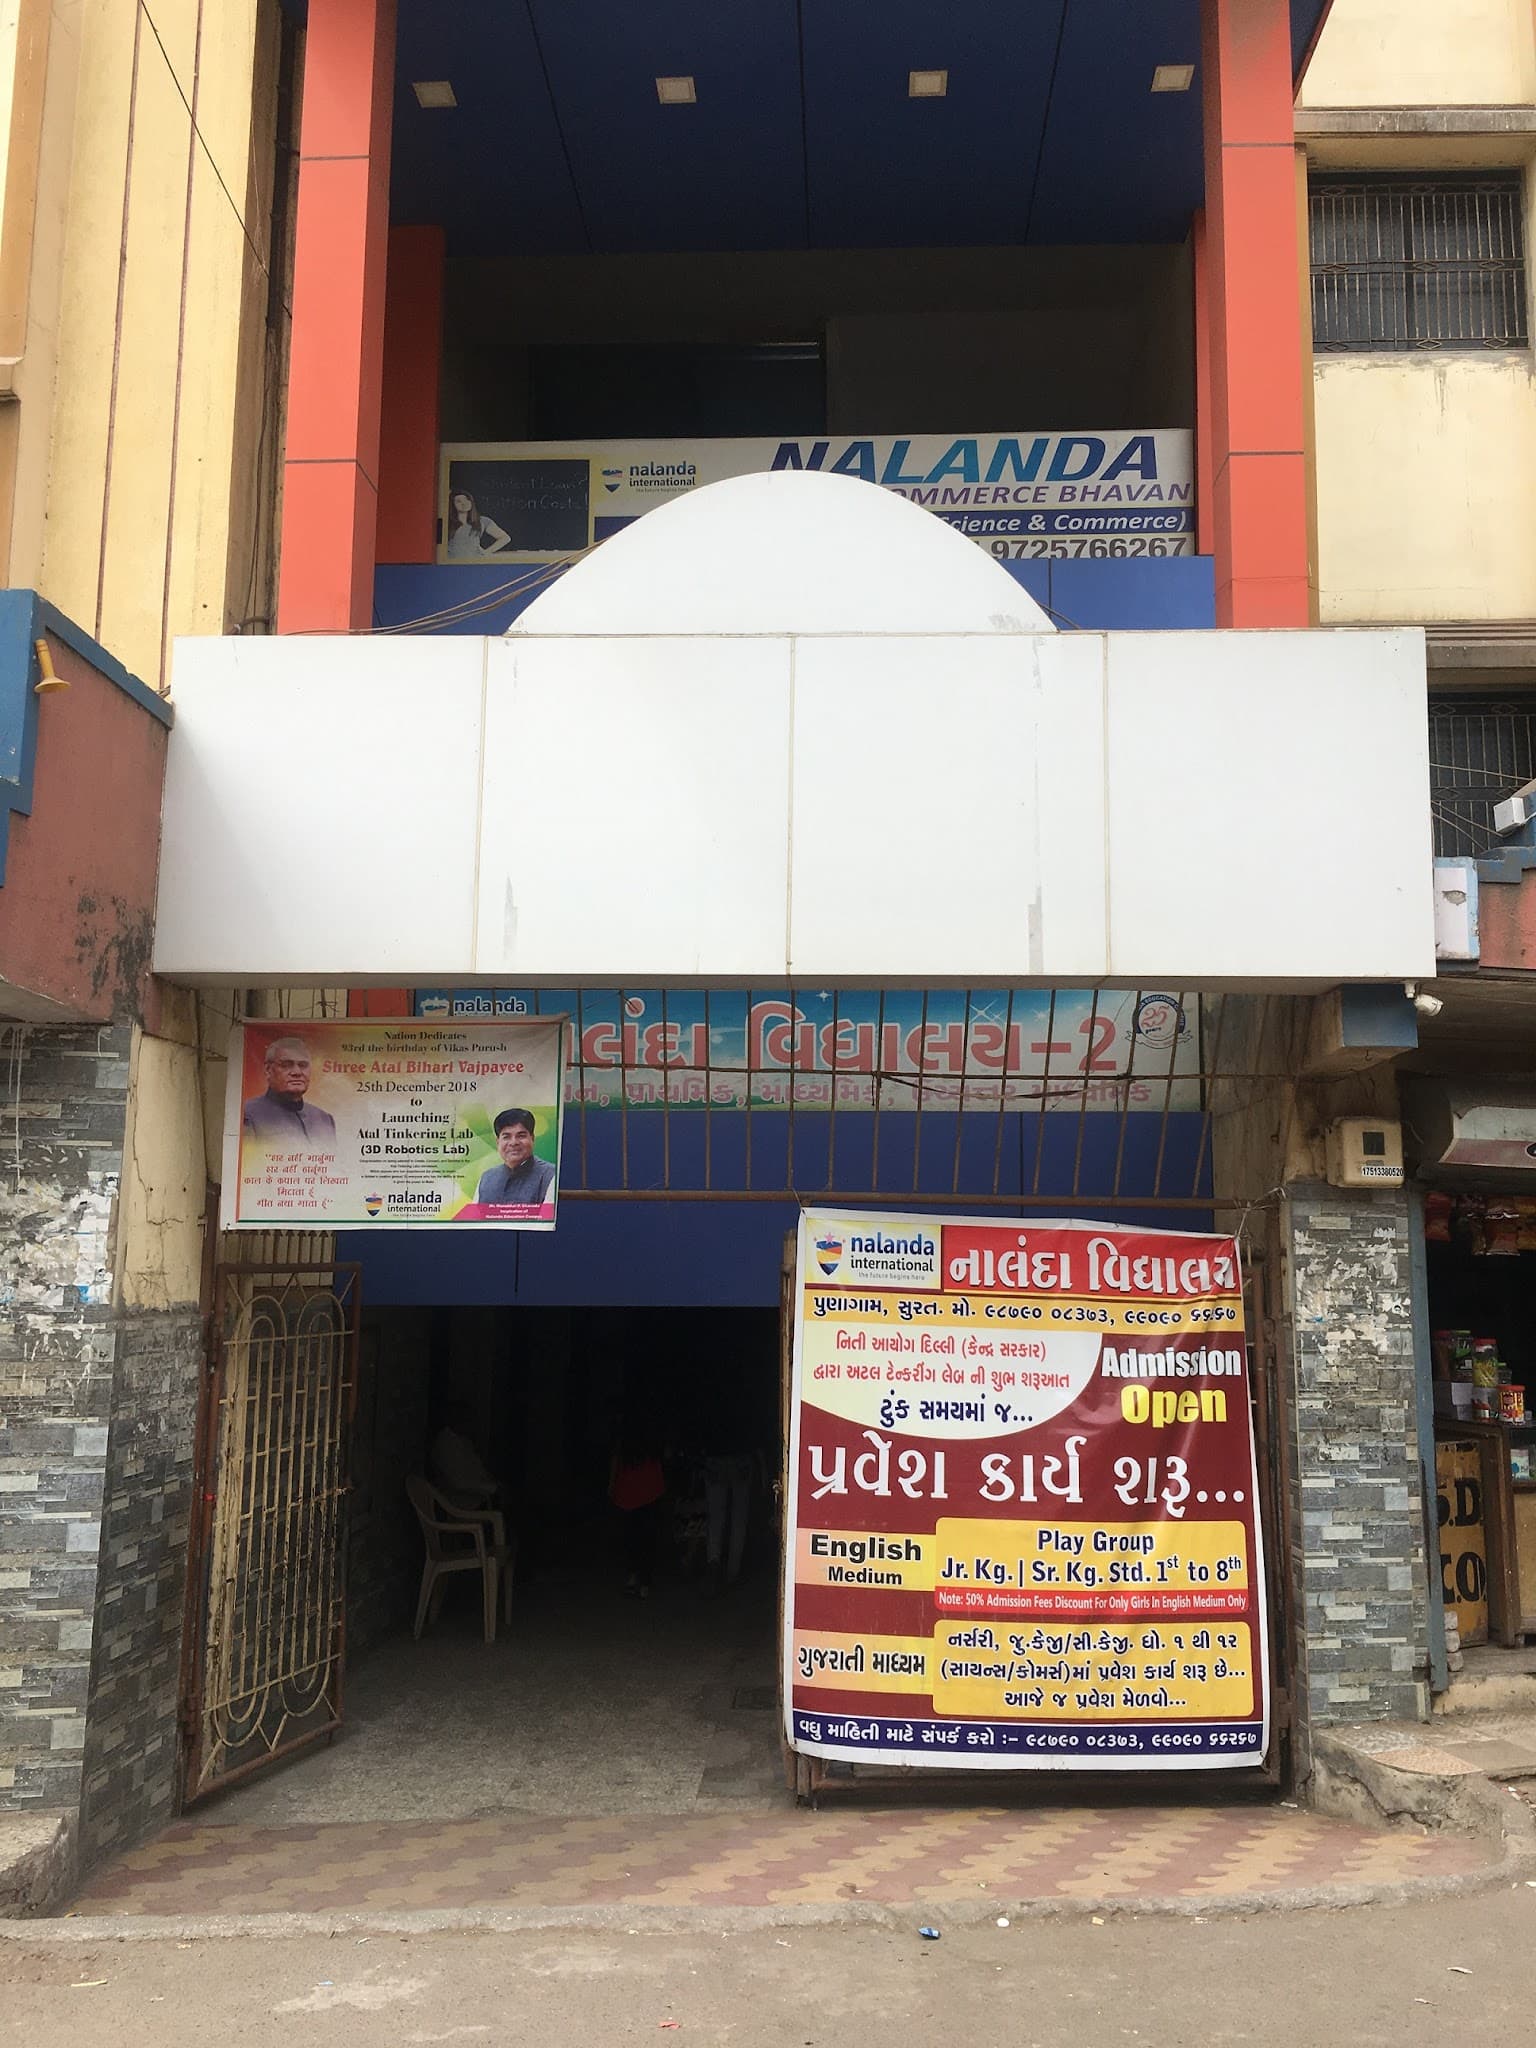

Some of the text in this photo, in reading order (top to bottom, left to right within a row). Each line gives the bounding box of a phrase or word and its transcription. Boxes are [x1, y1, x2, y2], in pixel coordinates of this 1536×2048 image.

[629, 461, 697, 476] nalanda
[770, 436, 1158, 484] NALANDA
[629, 476, 696, 488] international
[1058, 482, 1191, 504] BHAVAN
[1027, 514, 1047, 532] &
[1054, 511, 1187, 533] Commerce)
[991, 537, 1187, 559] 9725766267
[455, 997, 525, 1012] nalanda
[384, 1031, 467, 1041] Nation Dedicates
[367, 1043, 384, 1053] the
[386, 1043, 428, 1055] birthday
[431, 1043, 443, 1054] of
[444, 1043, 469, 1053] Vikas
[322, 1059, 525, 1076] Shree Atal Bihari Vajpayee
[356, 1080, 477, 1093] 25th December 2018
[410, 1097, 423, 1107] to
[381, 1112, 450, 1124] Launching
[357, 1128, 474, 1141] Atal Tinkering Lab
[360, 1144, 470, 1156] (3D Robotics Lab)
[388, 1190, 442, 1203] nalanda
[387, 1204, 441, 1213] international
[850, 1232, 935, 1256] nalanda
[850, 1256, 934, 1273] international
[949, 1234, 1237, 1294] નાલંદા વિદ્યાલય
[813, 1296, 888, 1316] પુણાગામ,
[951, 1297, 976, 1317] મો.
[984, 1304, 1042, 1319] ૯૮૭૯૦
[1050, 1307, 1115, 1326] ૦૮૩૭૩,
[1125, 1310, 1182, 1325] ૯૯૦૯૦
[836, 1329, 1047, 1362] નિતી આયોગ દિલ્લી (કેન્દ્ર સરકાર)
[1102, 1345, 1242, 1378] Admission
[846, 1364, 881, 1381] અટલ
[941, 1362, 965, 1384] લેબ
[970, 1366, 986, 1385] ની
[991, 1370, 1015, 1392] શુભ
[1020, 1371, 1070, 1391] શરૂઆત
[919, 1393, 986, 1423] સમયમાં
[1120, 1384, 1227, 1428] Open
[807, 1429, 1246, 1519] પ્રવેશ કાર્ય શરૂ...
[811, 1533, 922, 1564] English
[1037, 1529, 1155, 1555] Play Group
[828, 1566, 902, 1585] Medium
[941, 1557, 969, 1580] Jr.
[975, 1558, 1014, 1585] Kg.
[1032, 1559, 1060, 1583] Sr.
[1066, 1561, 1104, 1587] Kg.
[1109, 1561, 1152, 1583] Std.
[1156, 1555, 1179, 1583] 1st
[1188, 1560, 1209, 1582] to
[1215, 1555, 1242, 1582] 8th
[939, 1592, 1246, 1612] Note: 50% Admission Fees Discount For Only Girls In English Medium Only
[947, 1628, 1000, 1652] નર્સરી,
[1174, 1635, 1185, 1651] ૧
[1192, 1630, 1211, 1650] થી
[1217, 1634, 1238, 1650] ૧૨
[798, 1644, 925, 1678] ગુજરાતી માધ્યમ
[1097, 1661, 1137, 1682] પ્રવેશ
[1143, 1659, 1176, 1680] કાર્ય
[1182, 1663, 1207, 1683] શરૂ
[1213, 1658, 1246, 1680] છે...
[1004, 1686, 1186, 1710] આજે જ પ્રવેશ મેળવો...
[827, 1720, 880, 1741] માહિતી
[886, 1724, 914, 1742] માટે
[920, 1724, 962, 1744] સંપર્ક
[966, 1726, 995, 1745] કરો
[1025, 1734, 1080, 1748] ૯૮૭૯૦
[1086, 1734, 1145, 1750] ૦૮૩૭૩,
[1151, 1733, 1203, 1747] ૯૯૦૯૦
[1209, 1732, 1257, 1746] ૬૬૨૬૭
